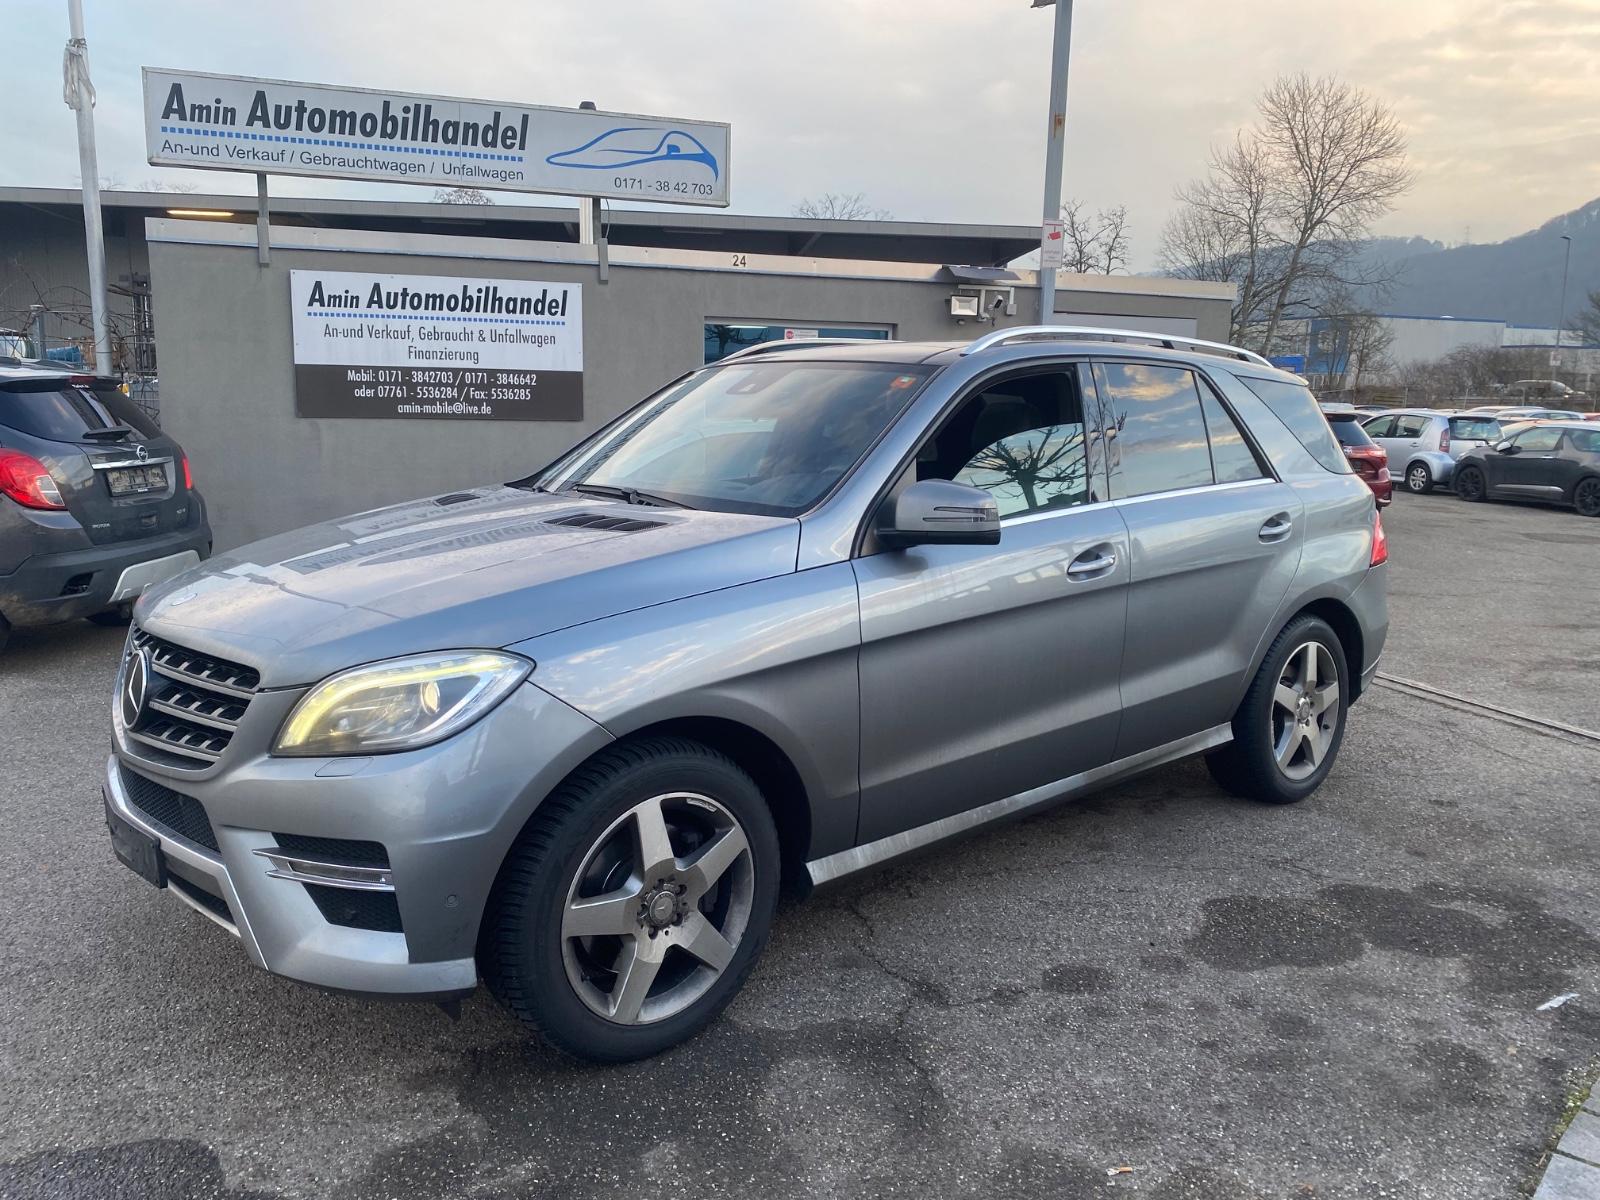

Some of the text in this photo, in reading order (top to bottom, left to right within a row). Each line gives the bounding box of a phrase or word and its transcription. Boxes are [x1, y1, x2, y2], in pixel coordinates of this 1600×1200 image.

[160, 82, 529, 151] Amin Automobilhandel
[161, 139, 220, 158] An-und
[225, 144, 286, 163] Verkauf
[300, 150, 426, 175] Gebrauchtwagen
[442, 162, 524, 182] Unfallwagen
[614, 177, 643, 191] 0171
[655, 179, 670, 193] 38
[673, 181, 688, 194] 42
[691, 182, 713, 196] 703
[732, 254, 747, 267] 24
[307, 280, 569, 317] Amin Automobilhandel
[323, 323, 556, 347] An-und Verkauf, Gebraucht & Unfallwagen
[408, 345, 480, 364] Finanzierung
[347, 369, 376, 382] Mobil:
[378, 370, 403, 383] 0171
[411, 371, 453, 384] 3842703
[464, 372, 488, 384] 0171
[496, 373, 537, 386] 3846642
[354, 386, 375, 398] oder
[377, 386, 407, 398] 07761
[416, 387, 459, 399] 5536284
[469, 387, 489, 400] Fax:
[490, 388, 532, 401] 5536285
[397, 401, 493, 415] amin-mobile@live.de
